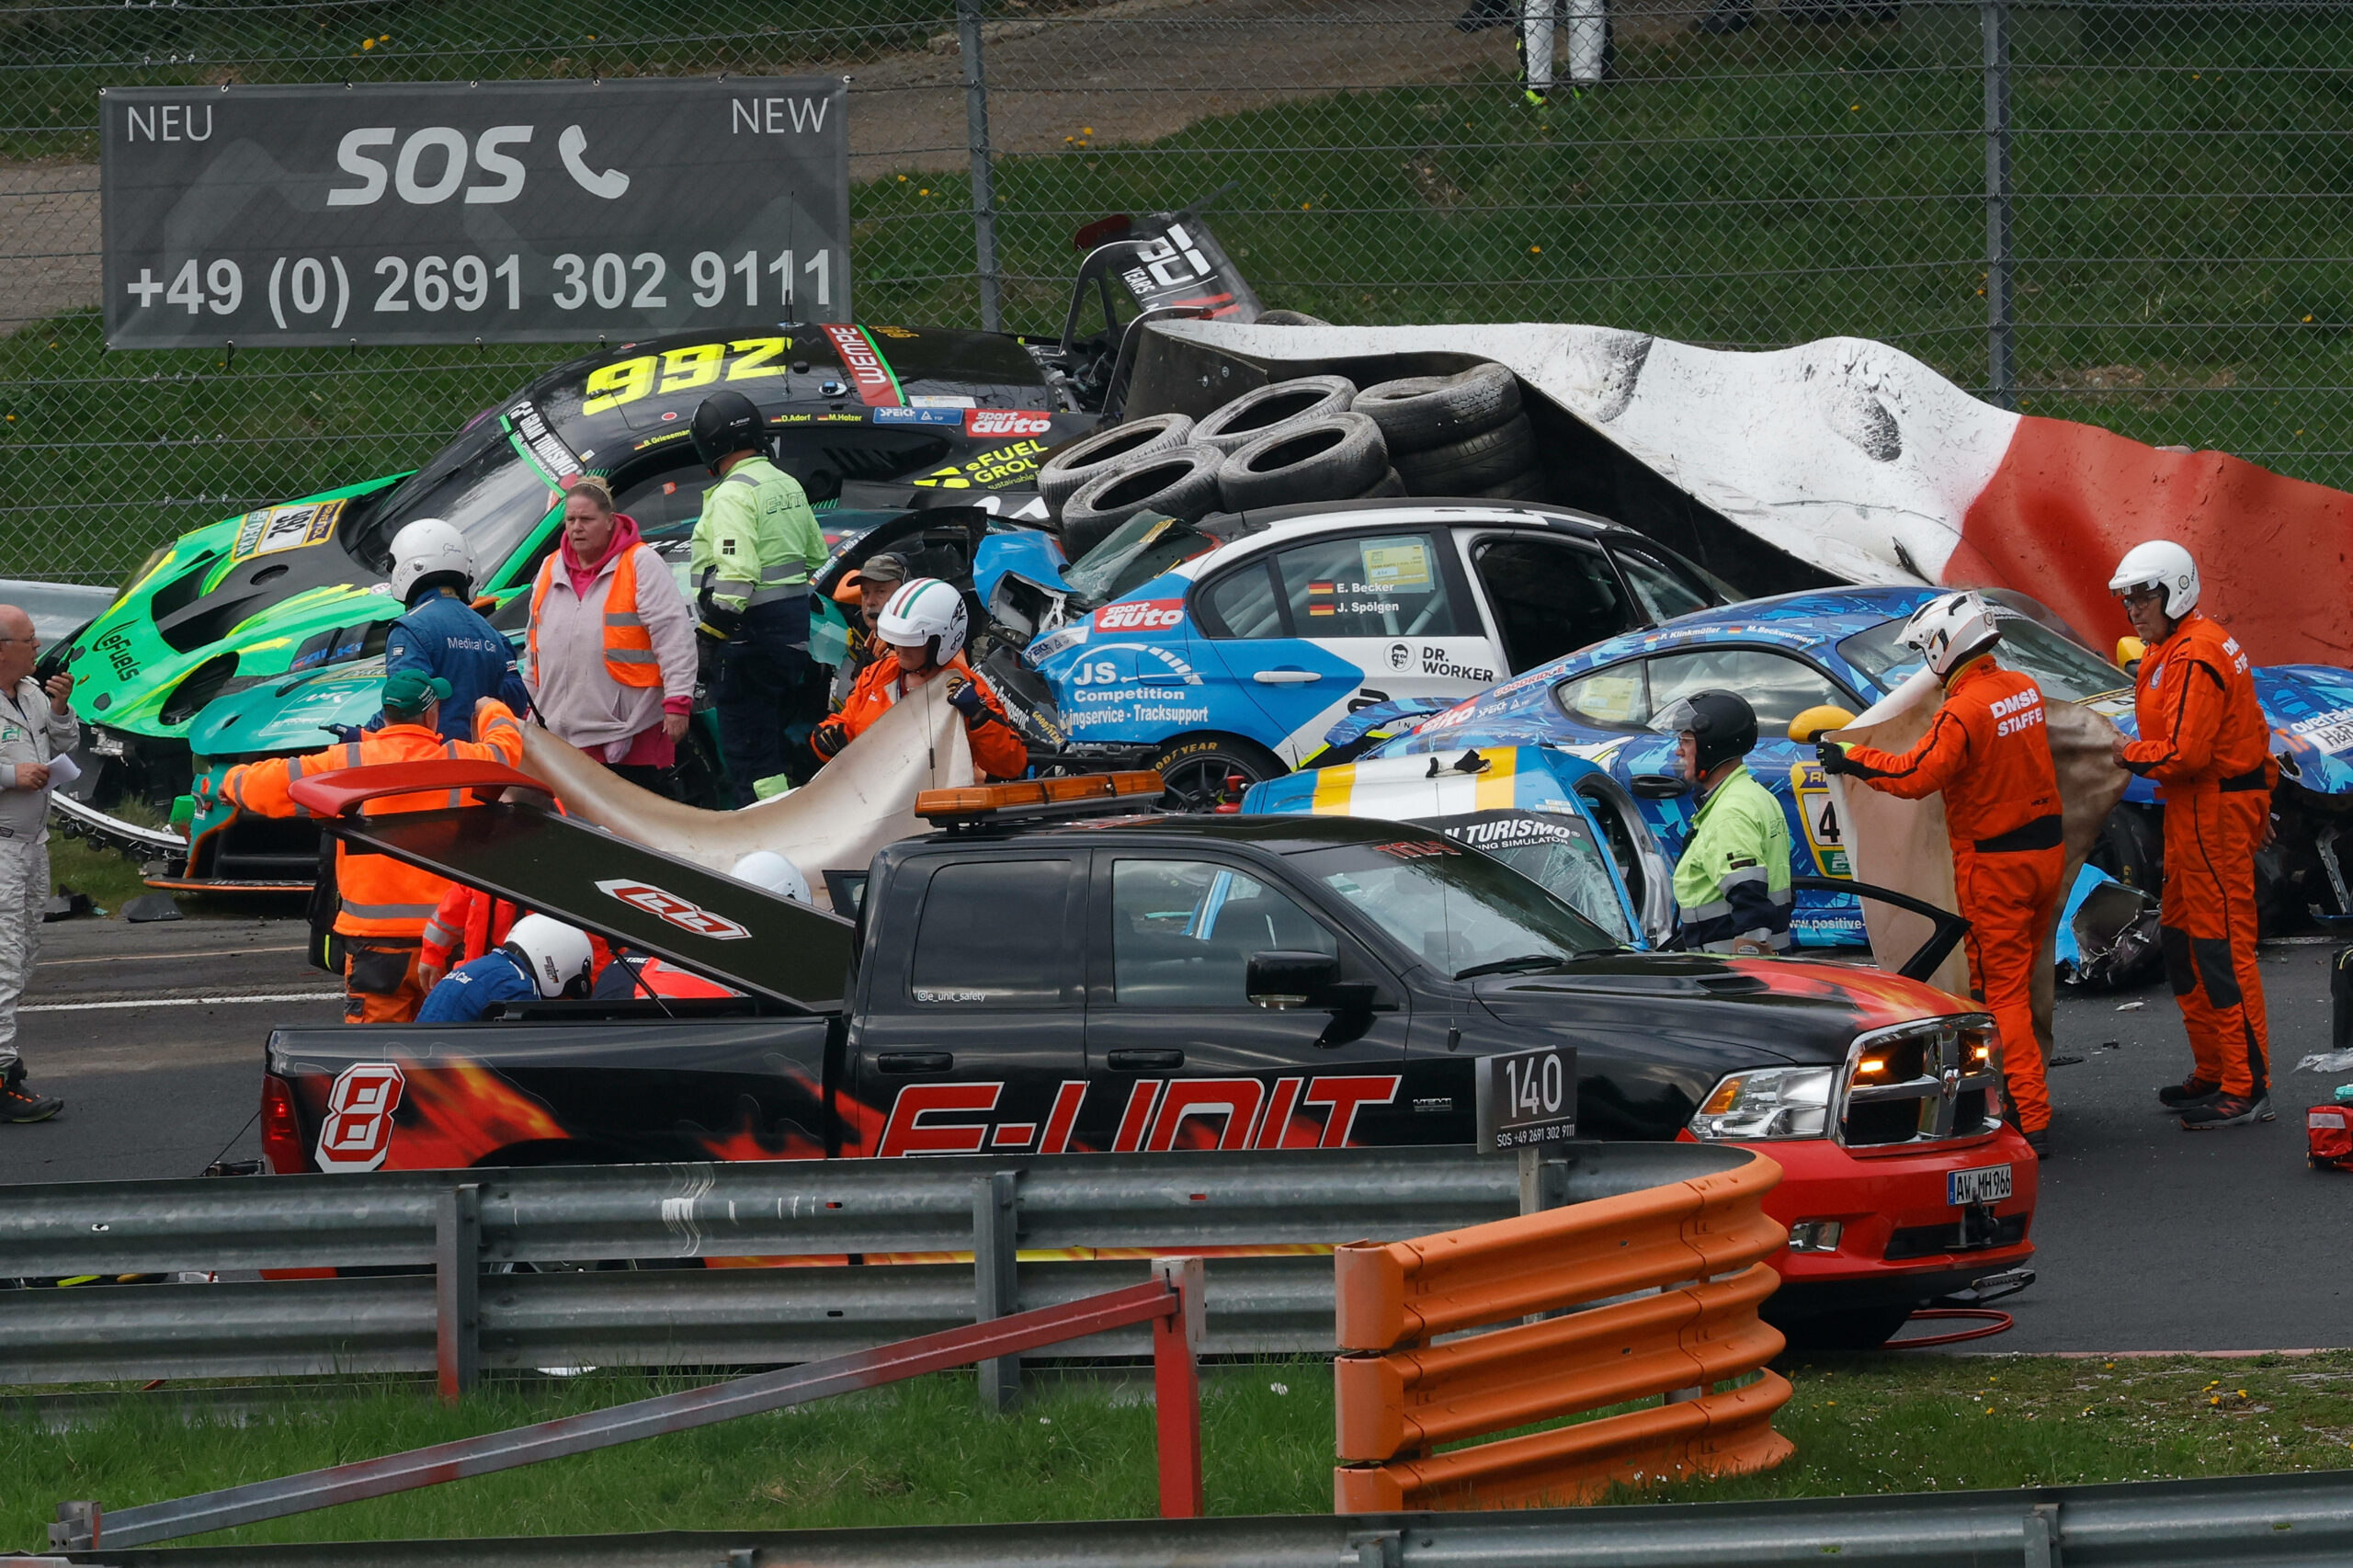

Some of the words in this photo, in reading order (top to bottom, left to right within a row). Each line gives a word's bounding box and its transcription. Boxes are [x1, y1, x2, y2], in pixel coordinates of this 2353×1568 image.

[127, 106, 213, 143] NEU
[732, 98, 829, 135] NEW
[326, 125, 534, 207] SOS
[127, 259, 244, 316] +49
[268, 256, 351, 329] (0)
[374, 254, 521, 313] 2691
[552, 251, 667, 310] 302
[690, 248, 831, 309] 9111
[1121, 267, 1155, 294] YEARS
[830, 326, 887, 384] WEMPE
[582, 336, 792, 416] 992
[519, 413, 548, 441] GRAN
[971, 417, 1051, 434] auto
[976, 411, 1019, 423] sport
[532, 433, 579, 477] TURISMO
[965, 438, 1049, 472] eFUEL
[987, 473, 1036, 491] sustainable
[267, 509, 314, 540] 992
[235, 521, 265, 558] DEKRA
[1336, 584, 1348, 594] E.
[1352, 582, 1395, 594] Becker
[1099, 608, 1185, 629] auto
[1105, 602, 1151, 617] sport
[1336, 603, 1348, 614] J.
[1351, 600, 1400, 615] Spölgen
[447, 636, 483, 652] Medical
[1422, 646, 1449, 663] DR.
[101, 634, 142, 682] eFuels
[1422, 660, 1494, 682] WORKER
[1074, 662, 1117, 686] JS
[1493, 664, 1567, 698] GOODRIDGE
[1074, 687, 1185, 703] Competition
[1988, 687, 2040, 720] DMSB
[1132, 704, 1209, 726] Tracksupport
[1501, 835, 1569, 848] SIMULATOR
[455, 970, 473, 984] Car
[927, 990, 986, 1003] e_unit_safety
[1506, 1053, 1563, 1119] 140
[314, 1062, 405, 1174] 8
[1496, 1132, 1512, 1148] SOS
[1514, 1130, 1528, 1144] +49
[1529, 1128, 1544, 1142] 2691
[1546, 1126, 1560, 1141] 302
[1562, 1123, 1575, 1138] 9111
[1993, 1168, 2011, 1196] 966
